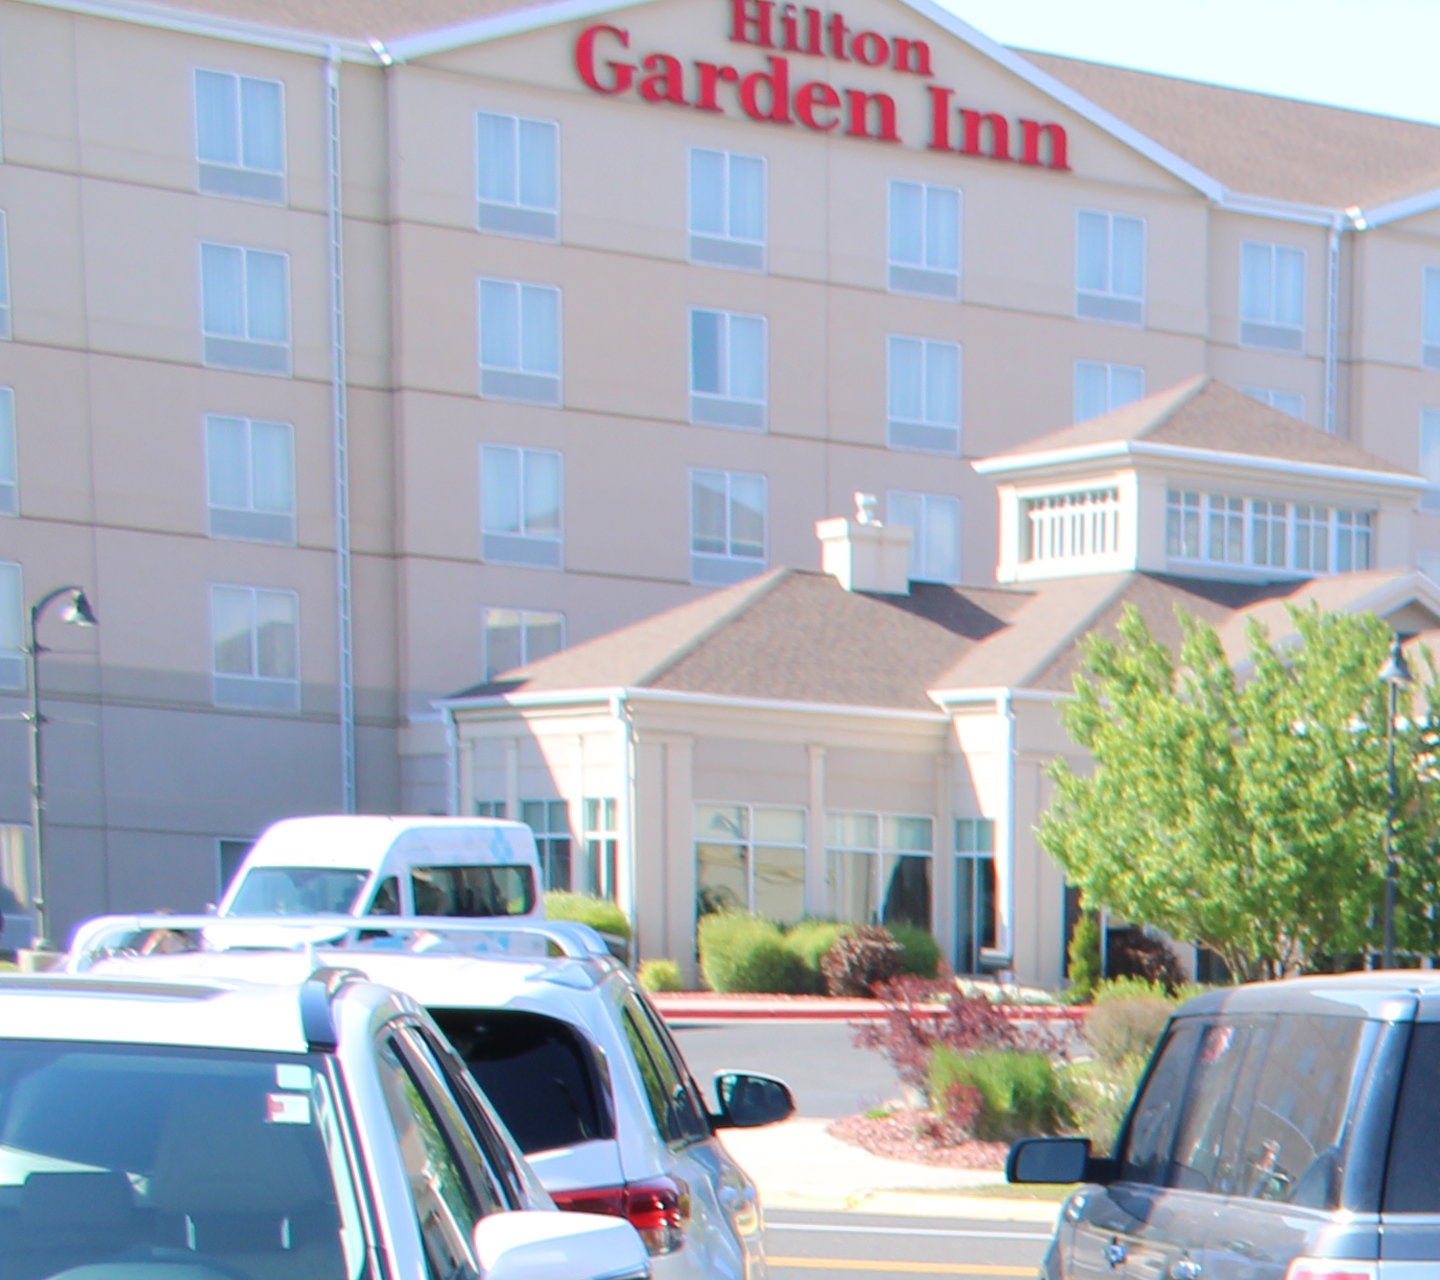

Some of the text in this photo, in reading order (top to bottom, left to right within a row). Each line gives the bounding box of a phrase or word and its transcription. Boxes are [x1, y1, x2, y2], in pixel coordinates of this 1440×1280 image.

[728, 0, 933, 76] Hilton
[573, 24, 1072, 171] Garden Inn
